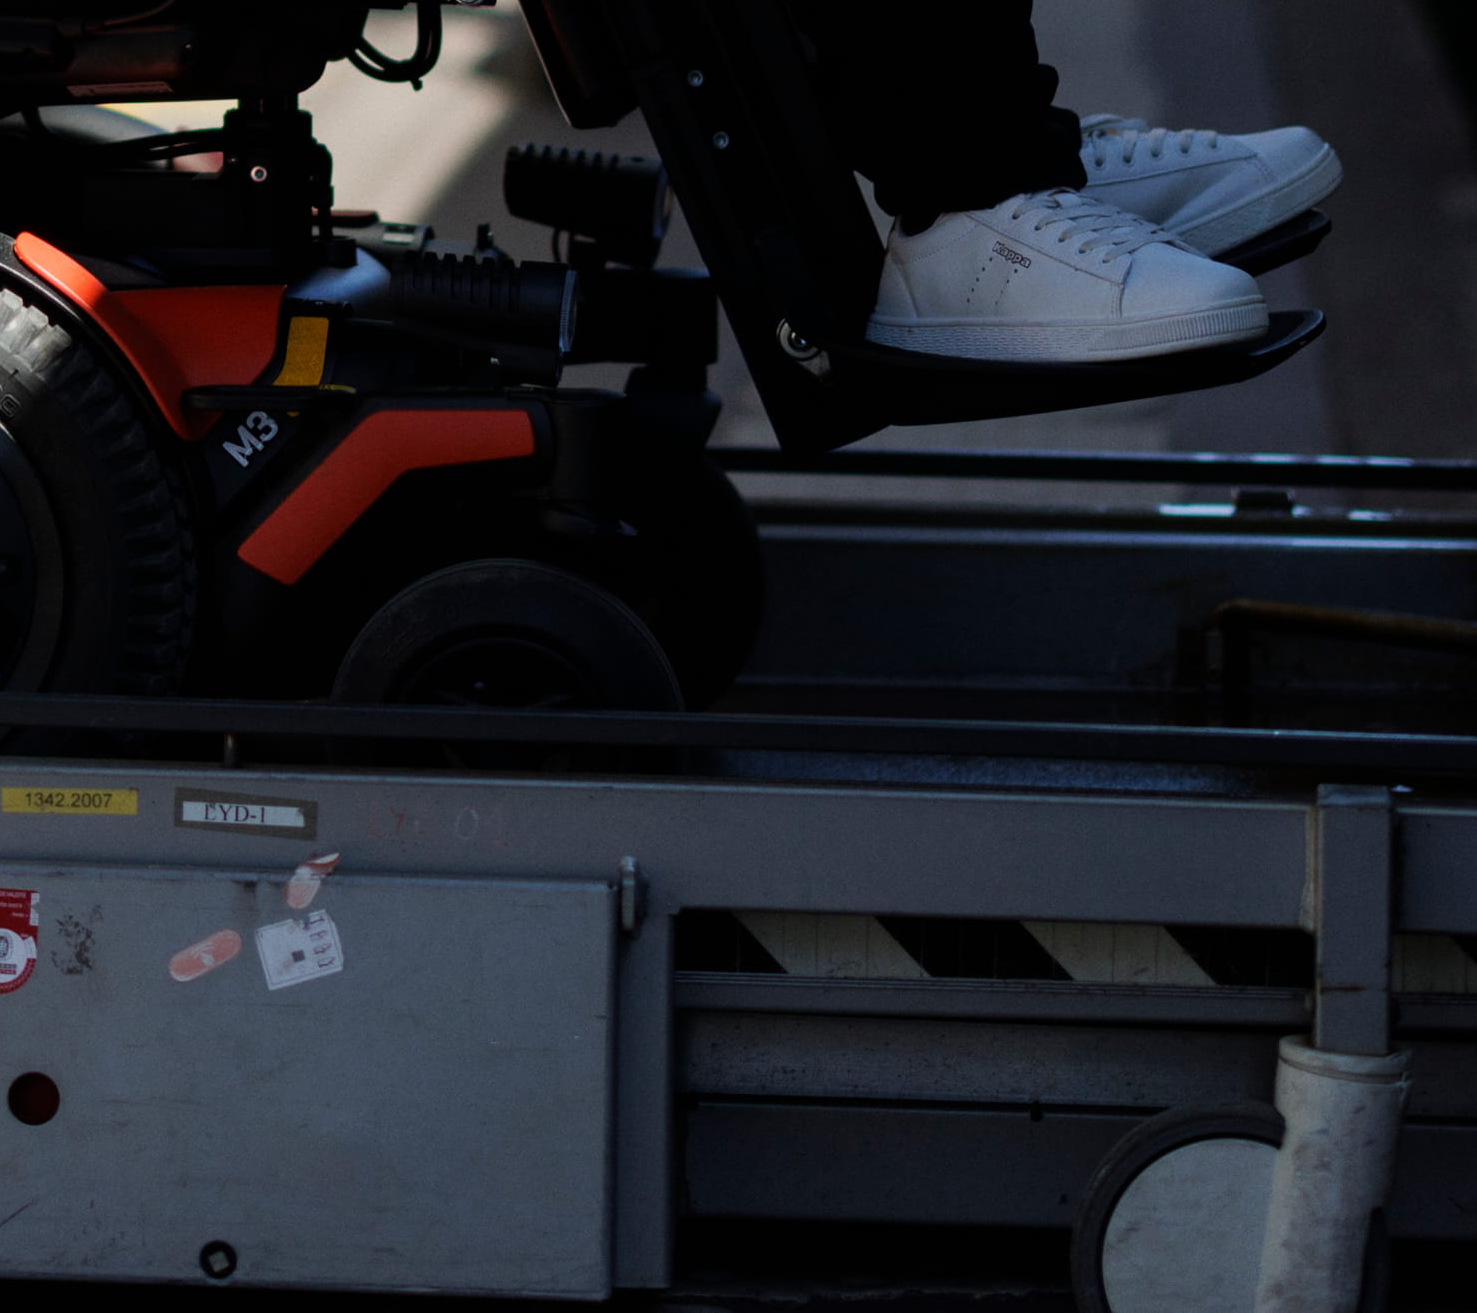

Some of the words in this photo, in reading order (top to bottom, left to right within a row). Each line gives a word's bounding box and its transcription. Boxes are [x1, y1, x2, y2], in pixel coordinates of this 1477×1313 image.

[992, 240, 1032, 269] Kappa
[222, 410, 279, 469] M3
[25, 792, 113, 809] 1342.2007
